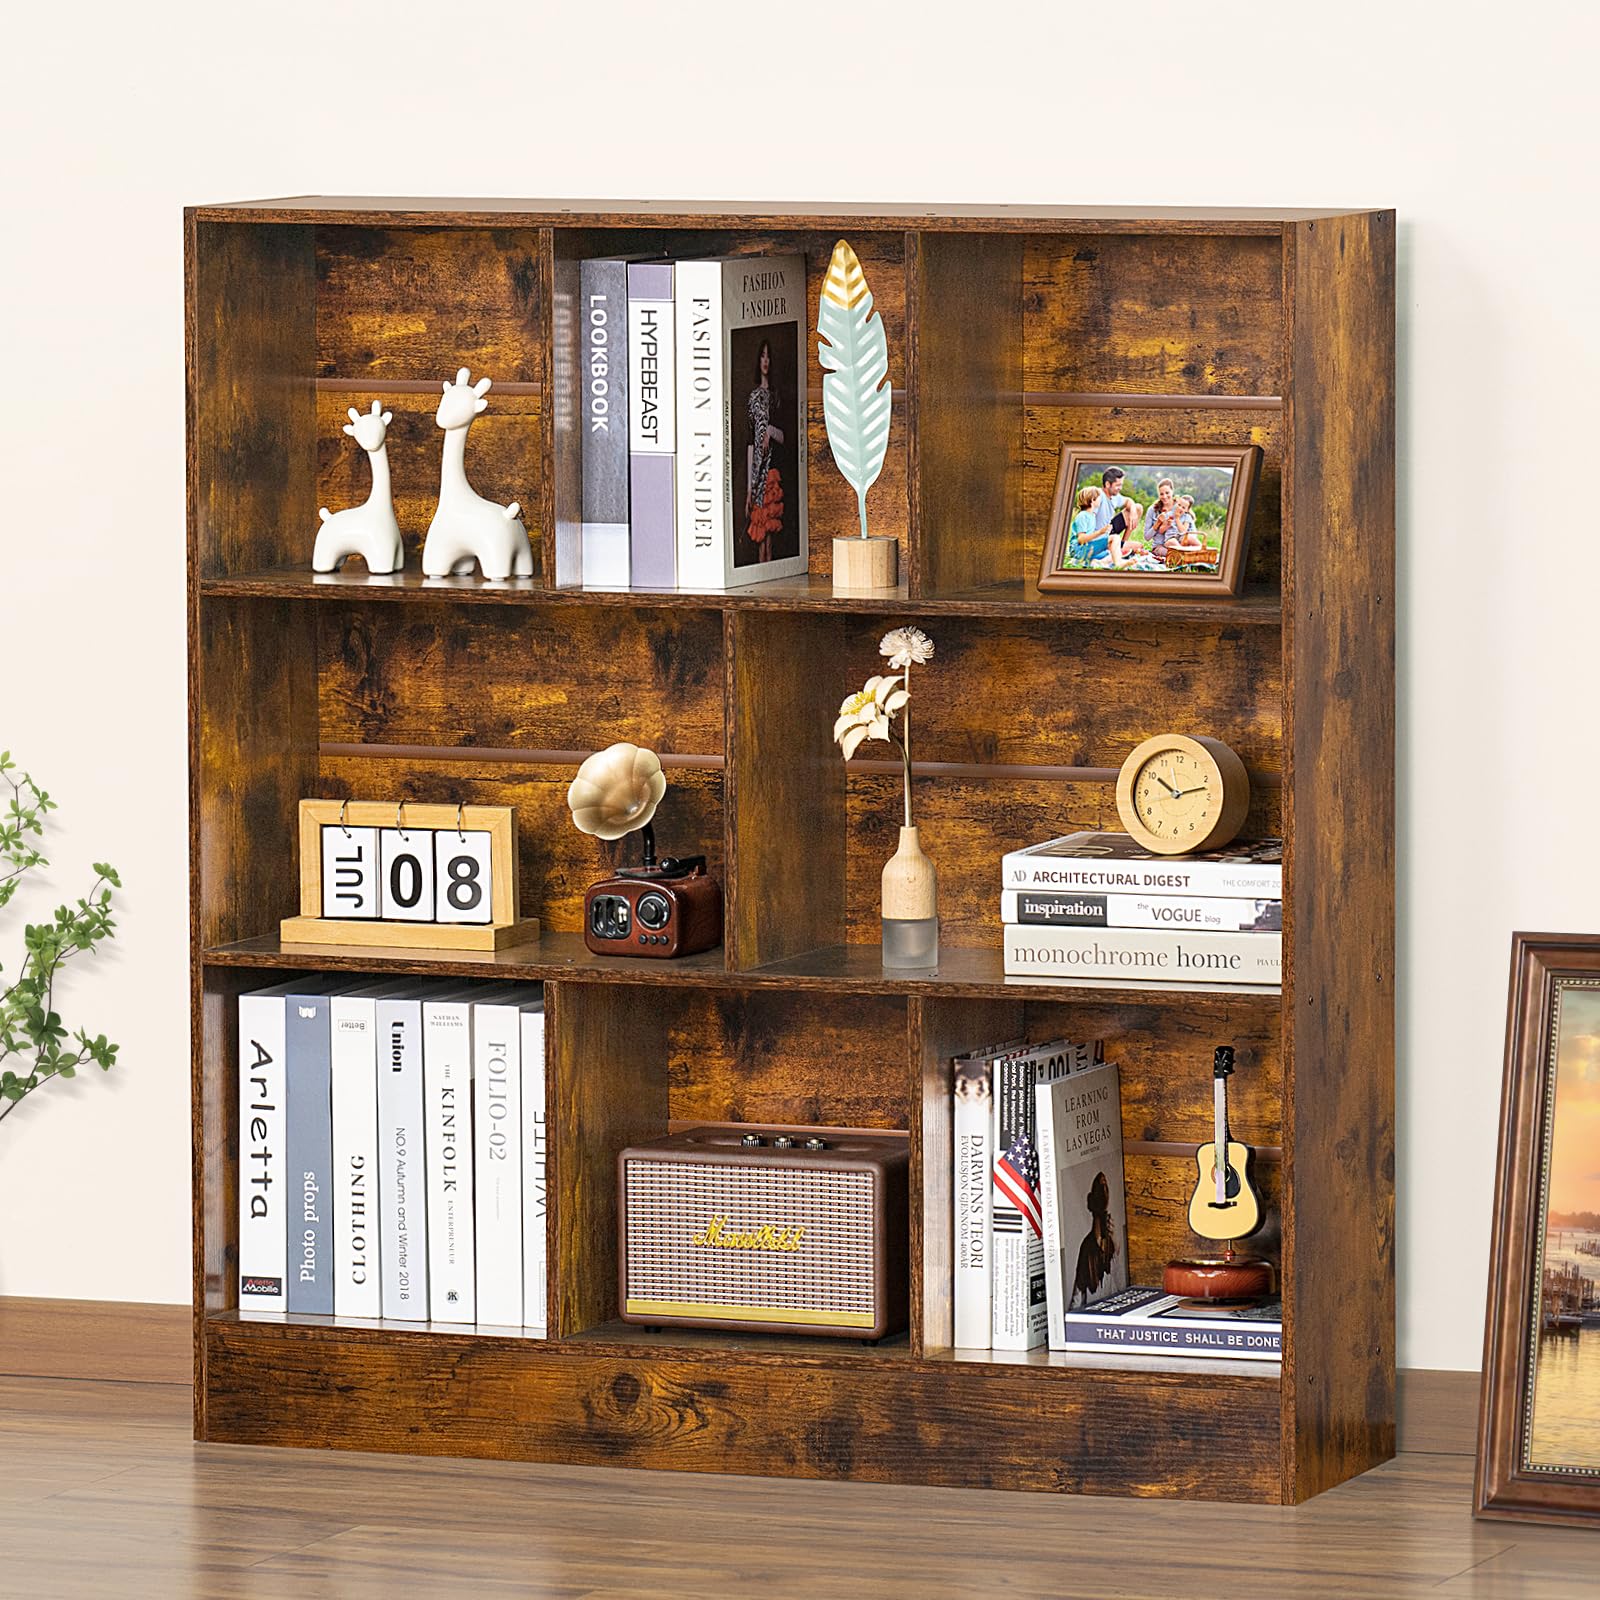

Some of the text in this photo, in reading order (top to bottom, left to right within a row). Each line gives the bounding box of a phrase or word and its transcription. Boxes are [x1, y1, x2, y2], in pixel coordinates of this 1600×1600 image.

[743, 271, 785, 293] FASHION
[590, 294, 609, 434] LOOKBOOK
[692, 298, 712, 410] FASHION
[640, 309, 659, 444] HYPEBEAST
[1176, 756, 1185, 764] 12
[1193, 761, 1198, 769] 1
[1148, 772, 1157, 780] 10
[1203, 775, 1209, 783] 2
[1144, 789, 1149, 797] 9
[1146, 807, 1152, 815] 8
[1158, 821, 1163, 829] 7
[1173, 827, 1178, 835] 6
[1189, 822, 1195, 831] 5
[335, 845, 364, 909] JUL
[1011, 870, 1027, 882] AD
[1032, 870, 1140, 887] ARCHITECTURAL
[1143, 874, 1191, 888] DIGEST
[1222, 879, 1236, 888] THE
[1236, 879, 1270, 889] COMFORT
[1023, 899, 1221, 925] inspiration the VOGUE blog
[1013, 943, 1169, 967] monochrome
[1176, 945, 1241, 969] home
[1256, 957, 1269, 967] PIA
[341, 1021, 366, 1031] Better
[391, 1021, 405, 1073] Union
[443, 1064, 451, 1080] THE
[488, 1041, 508, 1161] FOLIO-02
[1003, 1085, 1009, 1094] be
[1017, 1090, 1025, 1114] pictures
[1064, 1086, 1109, 1113] LEARNING
[250, 1039, 276, 1220] Arletta
[1075, 1109, 1100, 1129] FROM
[441, 1087, 457, 1193] KINFOLK
[1065, 1134, 1083, 1153] LAS
[1082, 1124, 1112, 1145] VEGAS
[959, 1135, 969, 1190] EVOLUSJON
[970, 1135, 985, 1269] DARWINS TEORI
[1041, 1129, 1057, 1264] LEARNING FROM LAS VEGAS
[300, 1171, 320, 1283] Photo props
[350, 1154, 366, 1285] CLOTHING
[395, 1127, 410, 1301] NO.9 Autumn and Winter 2018
[959, 1192, 969, 1240] GJENNOM
[243, 1283, 279, 1294] Mobile
[1096, 1328, 1280, 1348] THAT JUSTICE SHALL BE DONE
